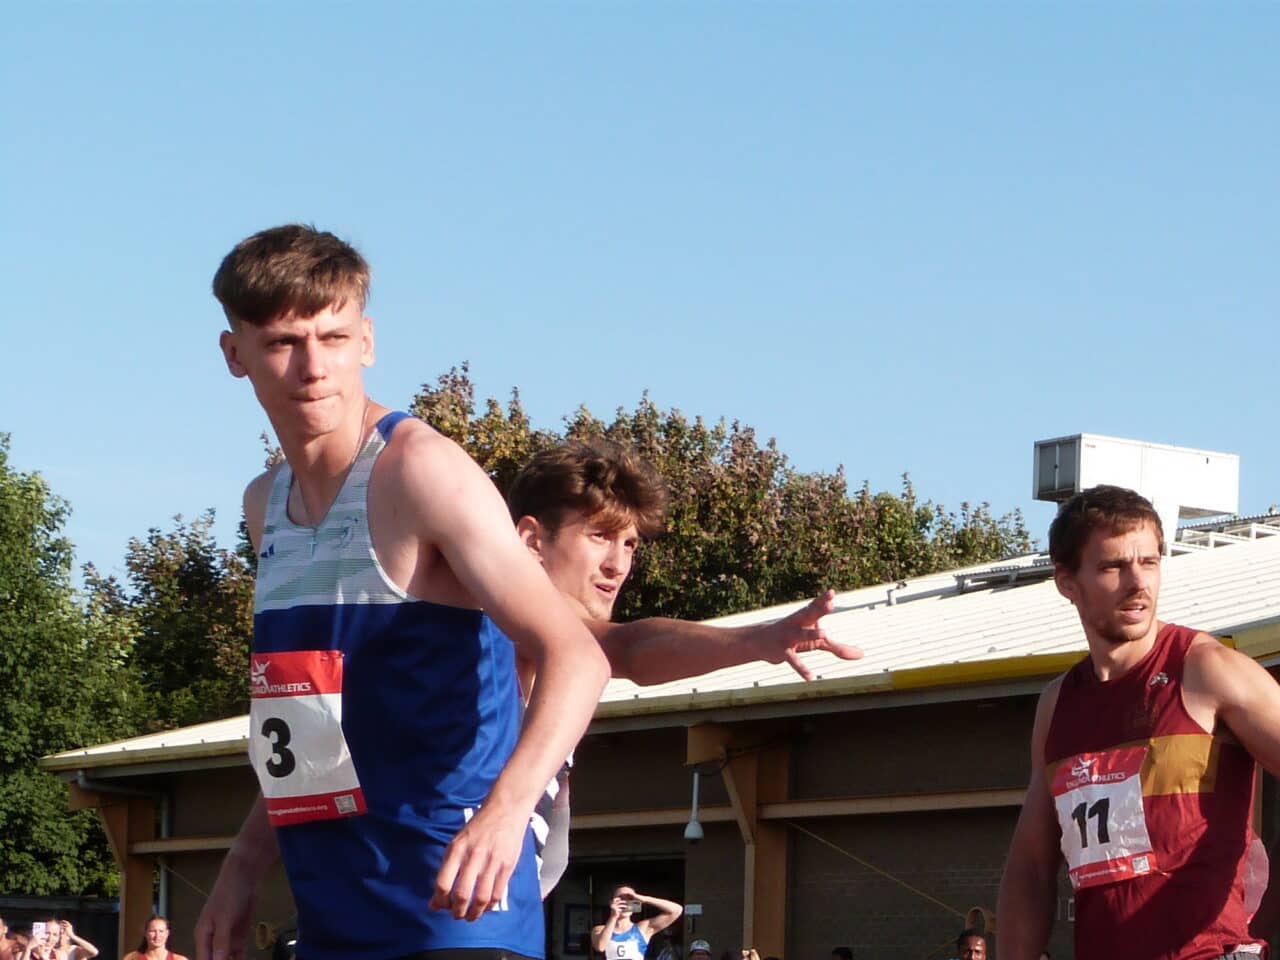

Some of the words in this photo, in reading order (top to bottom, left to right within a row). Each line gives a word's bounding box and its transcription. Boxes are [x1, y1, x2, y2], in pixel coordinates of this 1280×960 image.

[261, 717, 296, 778] 3
[1071, 797, 1111, 849] 11
[616, 944, 627, 958] G
